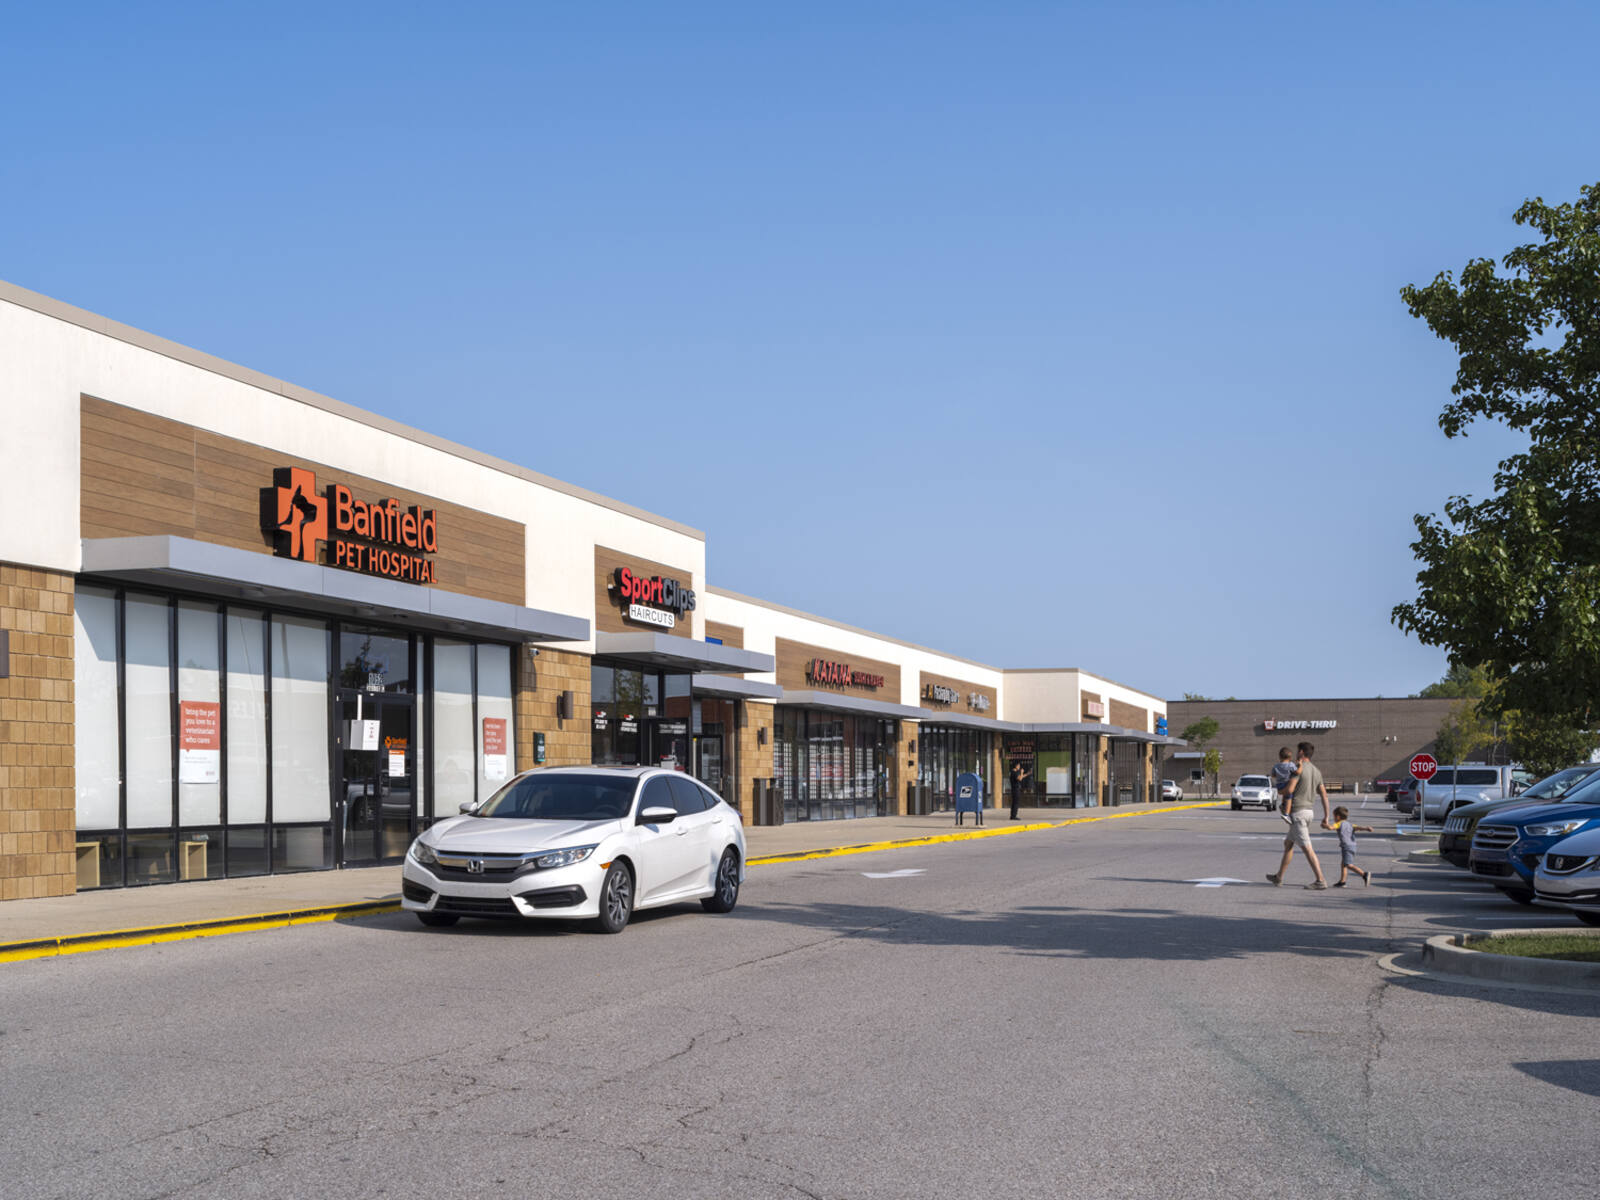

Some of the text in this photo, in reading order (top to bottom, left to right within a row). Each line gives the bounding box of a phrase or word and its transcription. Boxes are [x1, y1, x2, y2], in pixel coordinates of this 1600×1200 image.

[335, 484, 438, 553] Banfield
[336, 540, 438, 584] PET HOSPITAL
[630, 605, 674, 626] HAIRCUTS
[813, 657, 852, 686] KATANA
[1276, 720, 1337, 729] DRIVE-THRU
[1411, 762, 1436, 772] STOP
